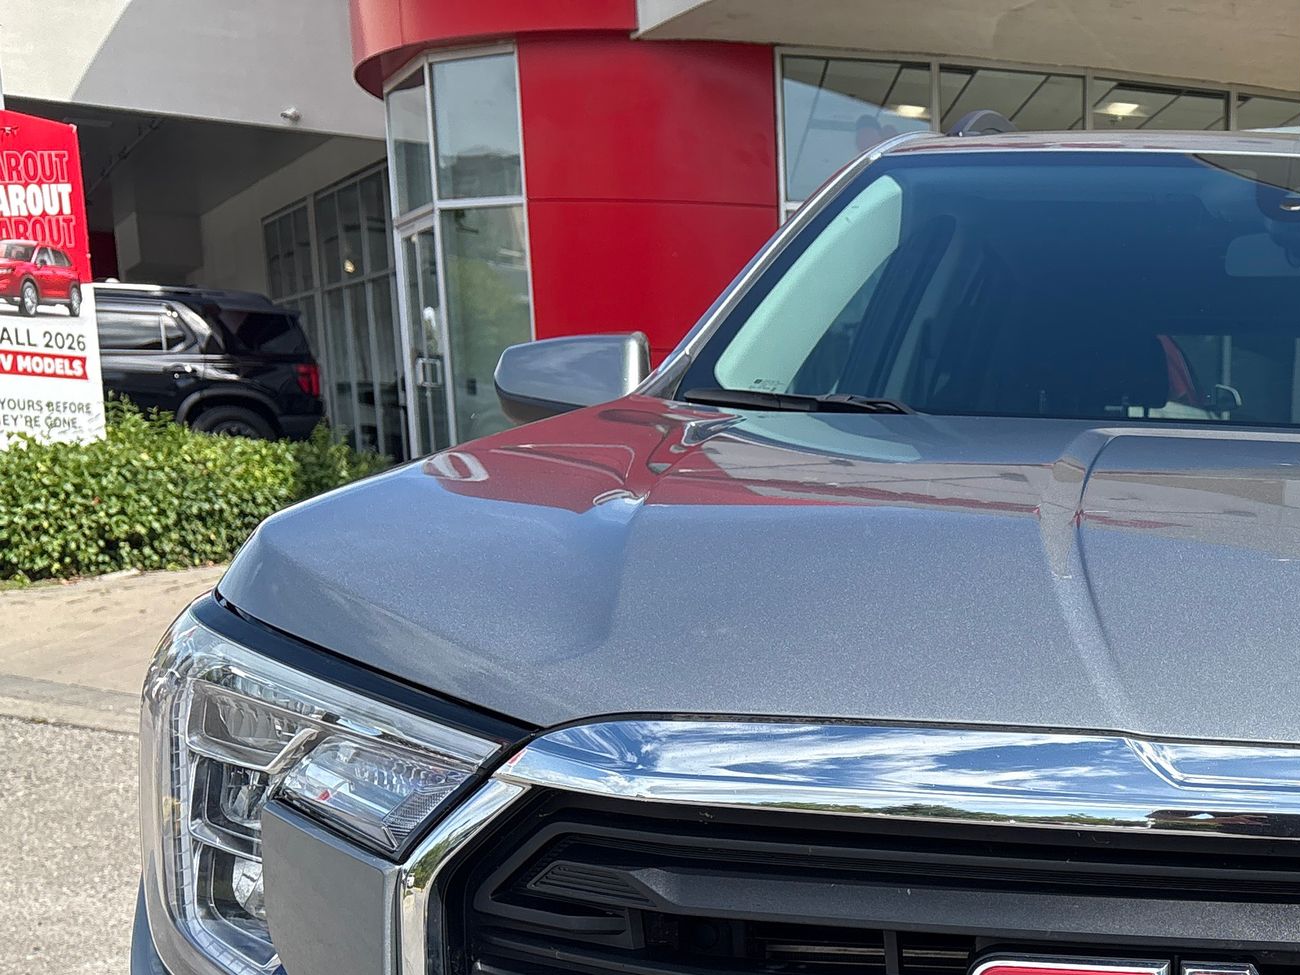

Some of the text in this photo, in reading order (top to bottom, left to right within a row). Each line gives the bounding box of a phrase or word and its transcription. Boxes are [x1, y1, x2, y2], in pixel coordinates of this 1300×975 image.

[0, 327, 86, 351] ALL 2026
[16, 354, 84, 377] MODELS
[0, 398, 92, 414] YOURS BEFORE
[0, 414, 41, 428] EY'RE
